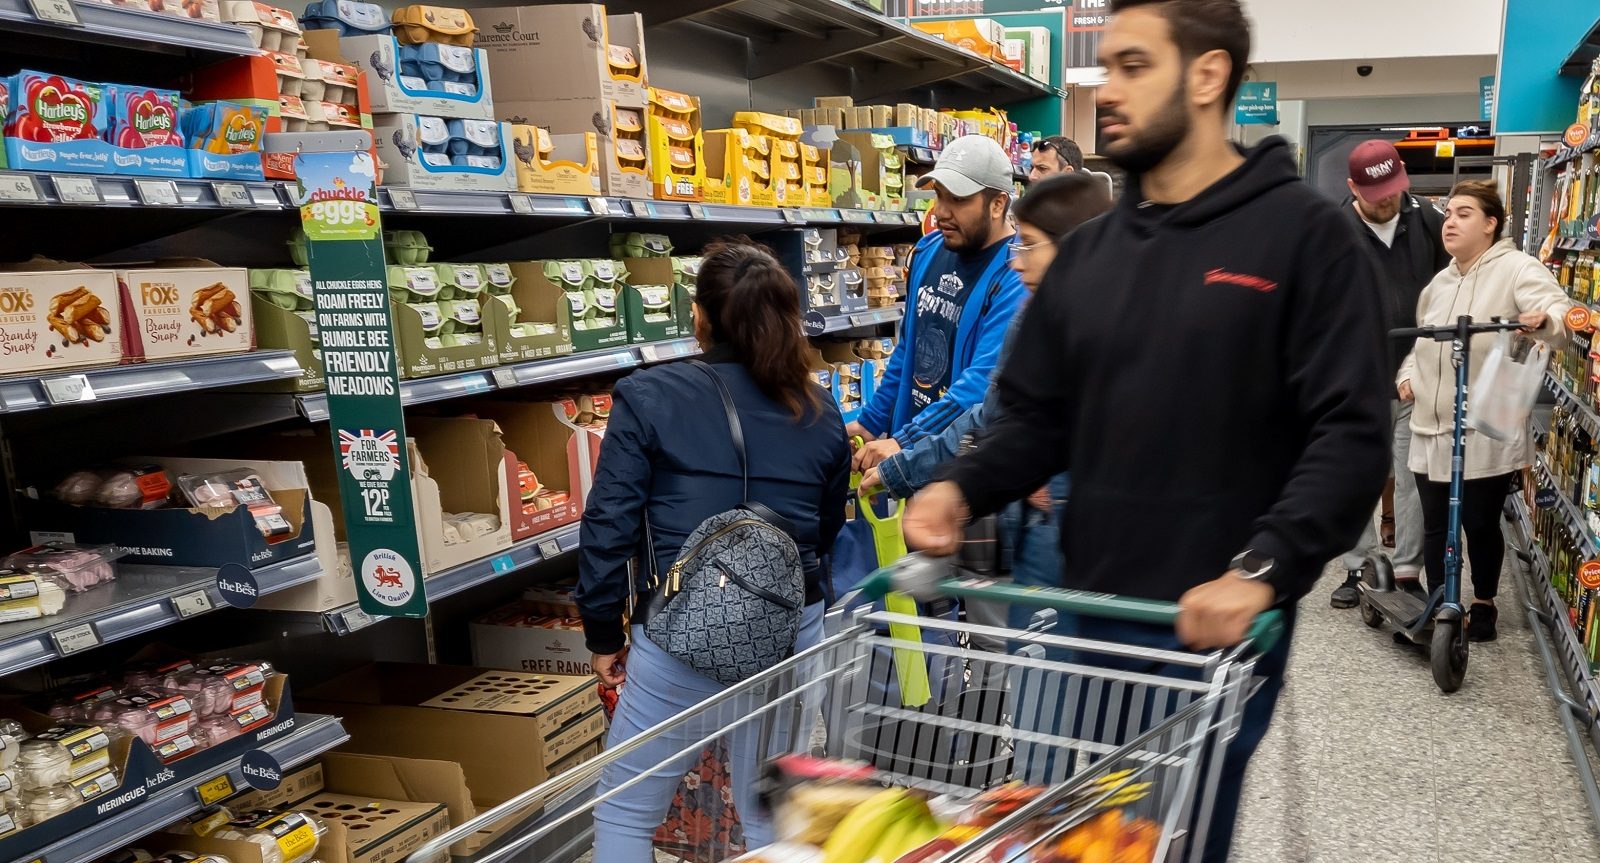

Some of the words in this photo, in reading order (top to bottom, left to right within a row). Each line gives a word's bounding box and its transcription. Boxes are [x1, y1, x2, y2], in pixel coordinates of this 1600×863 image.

[1074, 16, 1097, 25] FRESH
[1097, 16, 1104, 24] &
[473, 32, 510, 43] Clarence
[512, 30, 540, 42] Court
[39, 98, 85, 120] Hartley's
[135, 113, 171, 129] Hartley's
[226, 125, 256, 141] Hartley's
[1365, 158, 1394, 176] DKNY
[311, 186, 366, 201] chuckle
[676, 182, 694, 194] FREE
[312, 200, 366, 225] eggs
[316, 280, 327, 290] ALL
[327, 280, 352, 290] CHUCKLE
[352, 280, 366, 289] EGGS
[366, 280, 382, 289] HENS
[0, 286, 34, 313] OX'S
[317, 293, 347, 310] ROAM
[348, 293, 384, 309] FREELY
[144, 307, 181, 315] FABULOUS
[1570, 312, 1586, 321] Price
[145, 318, 182, 333] Brandy
[319, 313, 332, 327] ON
[333, 313, 363, 327] FARMS
[363, 312, 387, 327] WITH
[0, 327, 38, 343] Brandy
[151, 331, 179, 344] Snaps
[322, 330, 366, 347] BUMBLE
[367, 330, 389, 347] BEE
[3, 341, 35, 356] Snaps
[324, 350, 390, 373] FRIENDLY
[412, 363, 436, 373] Morrisons
[327, 376, 395, 396] MEADOWS
[360, 439, 377, 451] FOR
[351, 451, 390, 462] FARMERS
[142, 547, 173, 557] BAKING
[373, 552, 396, 561] British
[372, 588, 386, 600] Lion
[387, 590, 410, 602] Quality
[60, 635, 70, 643] OUT
[77, 630, 91, 639] STOCK
[557, 660, 594, 675] RANG
[256, 717, 295, 742] MERINGUES
[97, 785, 146, 815] MERINGUES
